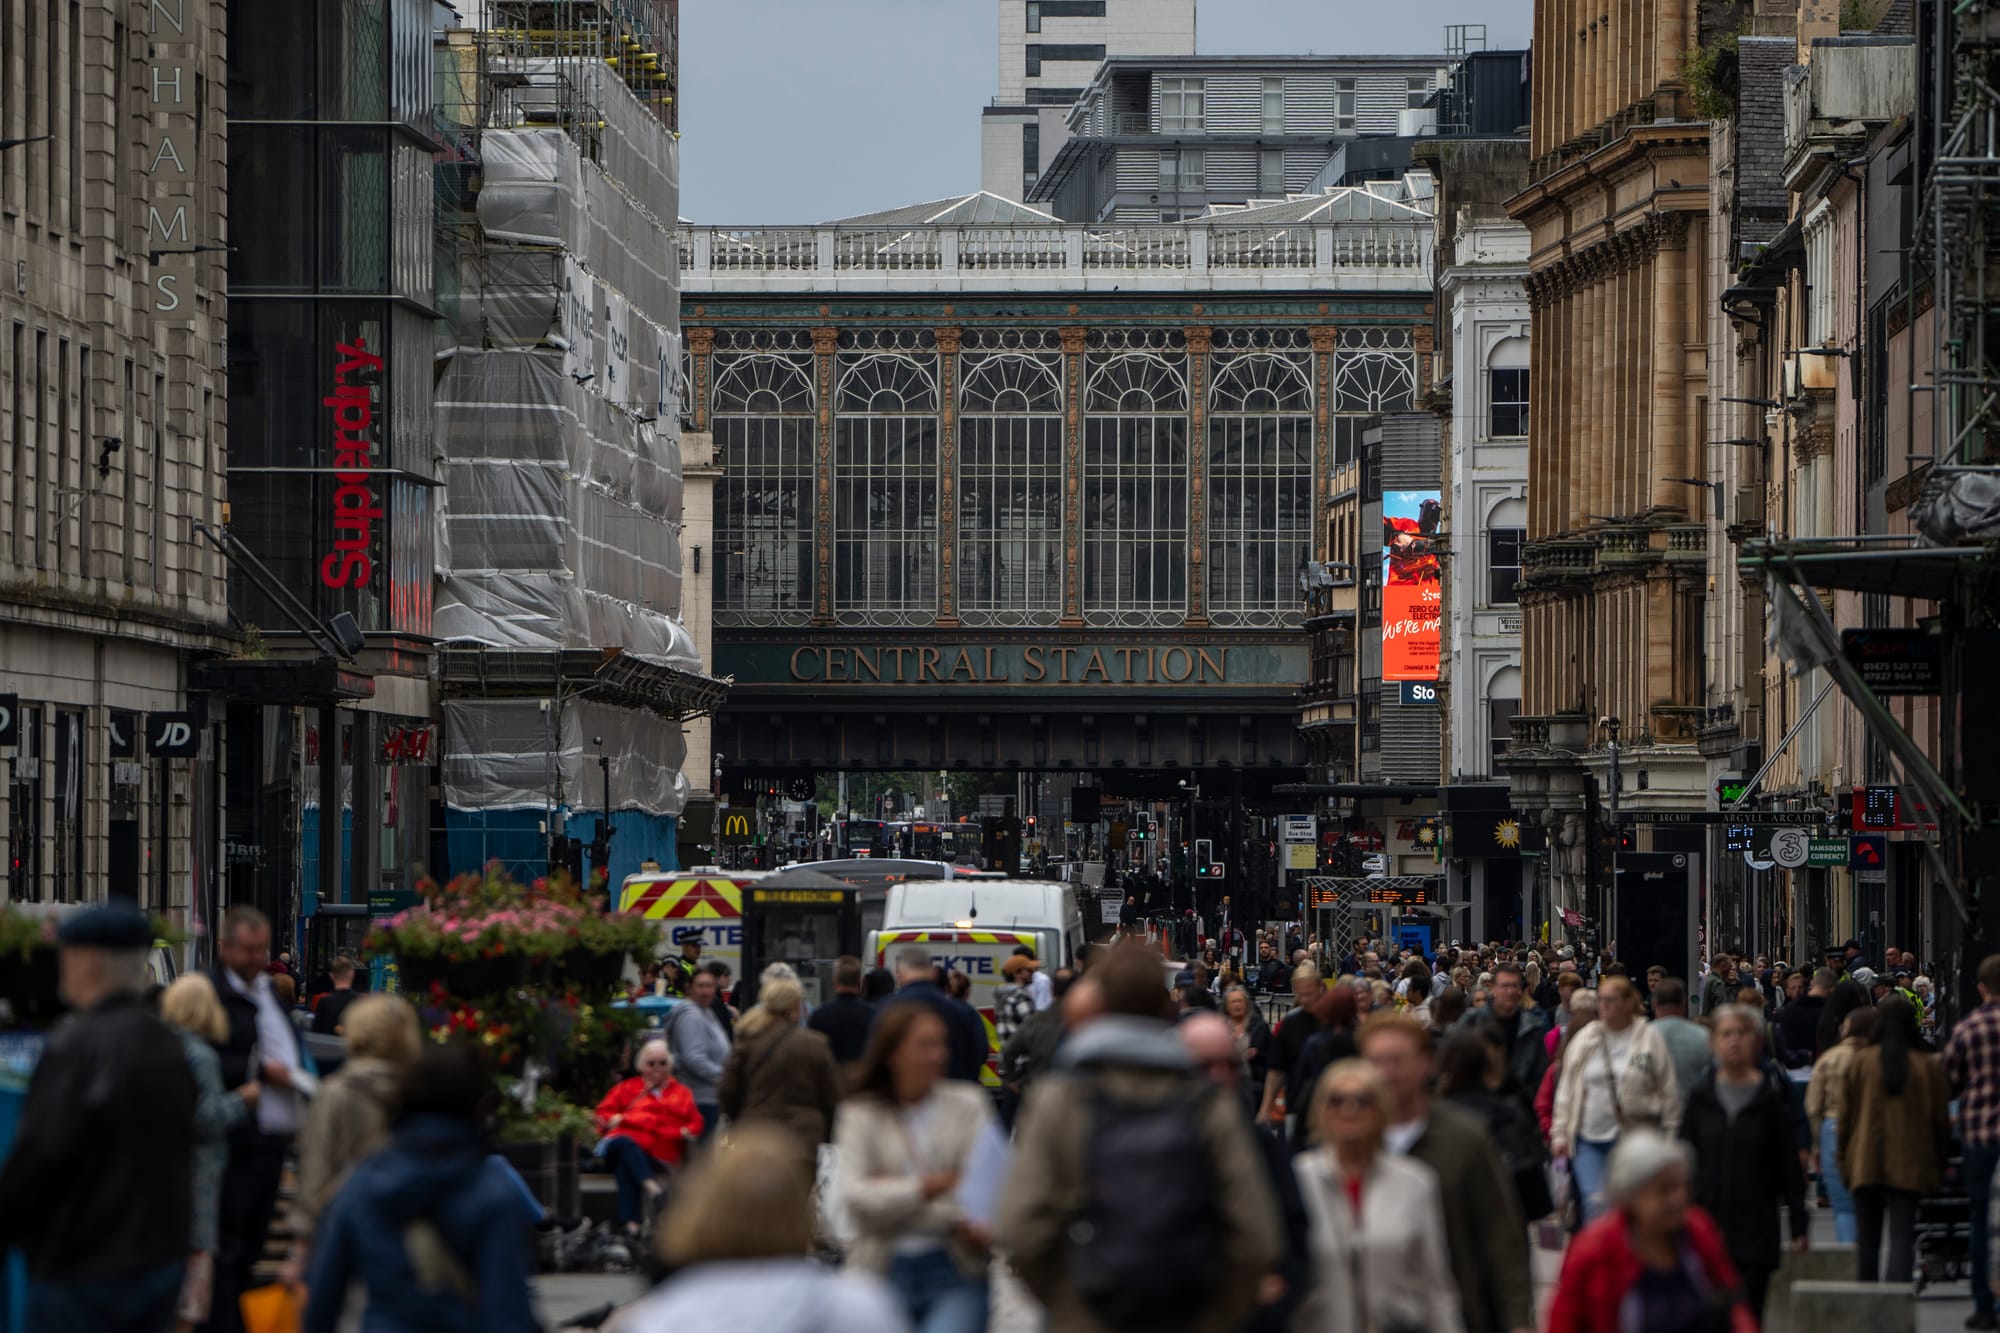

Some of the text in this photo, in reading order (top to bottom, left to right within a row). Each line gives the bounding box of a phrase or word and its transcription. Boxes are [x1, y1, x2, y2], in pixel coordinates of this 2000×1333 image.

[321, 337, 384, 589] Superdry.
[1383, 619, 1419, 640] WE'RE
[789, 646, 1228, 681] CENTRAL STATION
[1413, 685, 1435, 700] Sto
[155, 722, 191, 747] JD
[1659, 814, 1692, 823] ARCADE
[1722, 814, 1818, 823] ARGYLL ARCADE
[1780, 833, 1803, 862] 3
